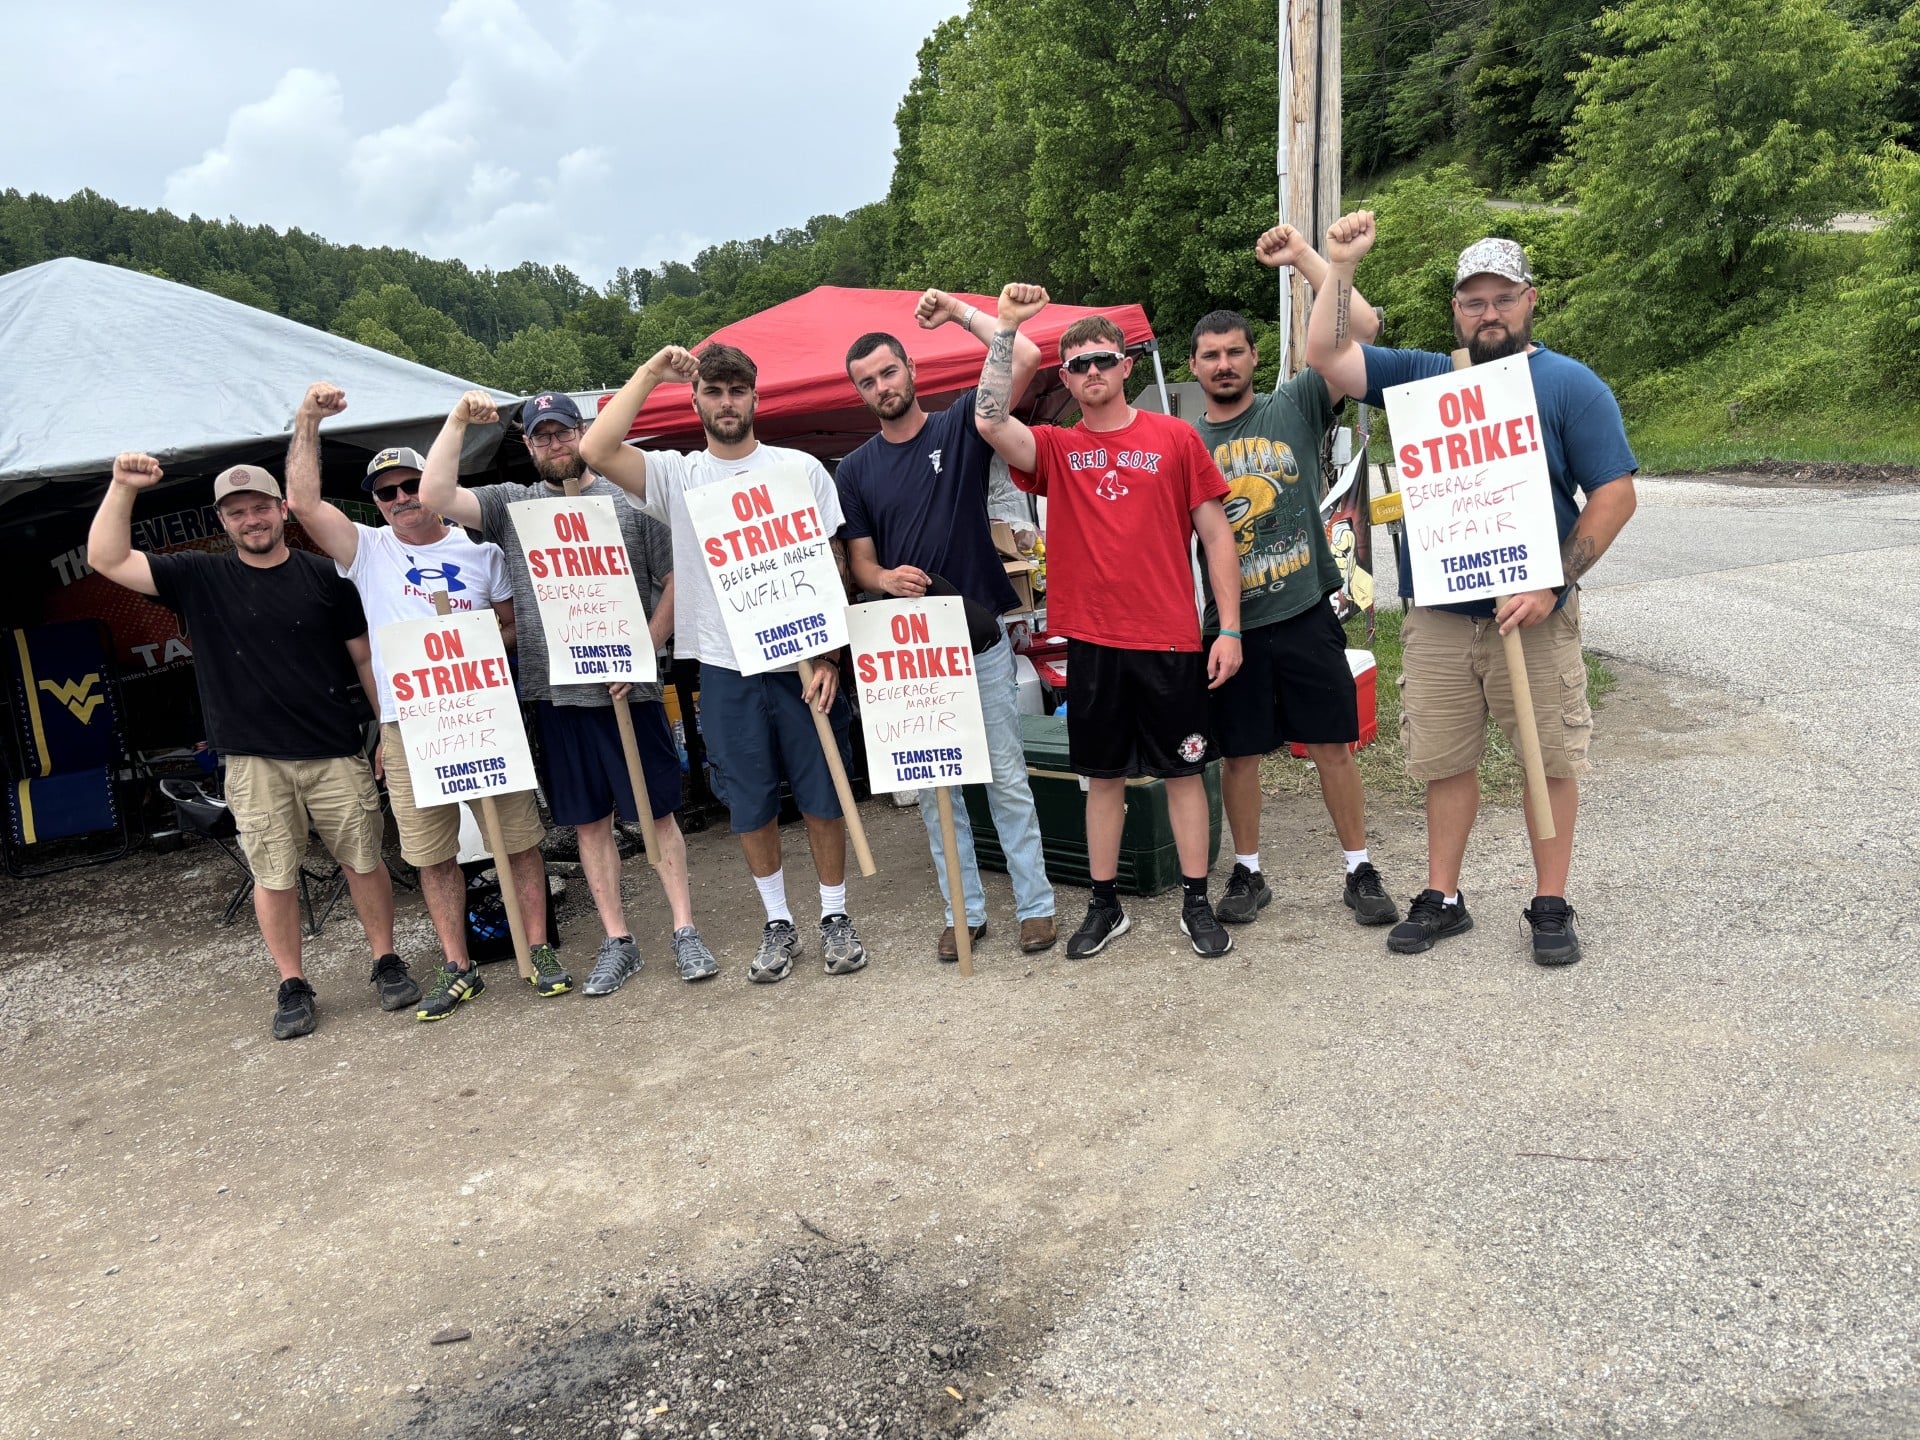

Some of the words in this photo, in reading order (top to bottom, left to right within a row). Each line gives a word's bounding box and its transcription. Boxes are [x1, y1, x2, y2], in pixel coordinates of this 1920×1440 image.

[1438, 384, 1486, 428] ON
[1067, 448, 1107, 470] RED
[1116, 450, 1161, 472] SOX
[1214, 436, 1299, 485] CKERS
[1399, 414, 1538, 479] STRIKE!
[732, 484, 774, 521] ON
[1407, 468, 1488, 510] BEVERAGE
[1452, 480, 1528, 517] MARKET
[554, 512, 589, 543] ON
[704, 507, 822, 567] STRIKE!
[1418, 512, 1516, 551] UNFAIR
[50, 545, 93, 586] TH
[131, 505, 227, 552] EVERA
[1440, 544, 1528, 574] TEAMSTERS
[529, 546, 629, 578] STRIKE!
[719, 558, 778, 592] BEVERAGE
[783, 542, 826, 566] MARKET
[537, 583, 607, 601] BEVERAGE
[729, 570, 816, 612] UNFAIR
[1447, 571, 1494, 592] LOCAL
[1499, 565, 1528, 583] 175
[569, 601, 622, 620] MARKET
[558, 620, 630, 643] UNFAIR
[755, 613, 826, 645] TEAMSTERS
[890, 613, 930, 644] ON
[424, 629, 464, 661] ON
[569, 644, 632, 659] TEAMSTERS
[763, 638, 803, 661] LOCAL
[805, 630, 828, 647] 175
[393, 657, 509, 701] STRIKE!
[575, 661, 609, 675] LOCAL
[612, 660, 632, 673] 175
[857, 646, 972, 683] STRIKE!
[399, 693, 478, 721] BEVERAGE
[866, 681, 939, 704] BEVERAGE
[906, 691, 964, 710] MARKET
[438, 708, 496, 732] MARKET
[876, 711, 956, 742] UNFAIR
[416, 729, 496, 761] UNFAIR
[891, 747, 962, 765] TEAMSTERS
[435, 757, 506, 780] TEAMSTERS
[441, 778, 481, 795] LOCAL
[484, 773, 507, 787] 175
[897, 765, 935, 781] LOCAL
[939, 763, 962, 777] 175
